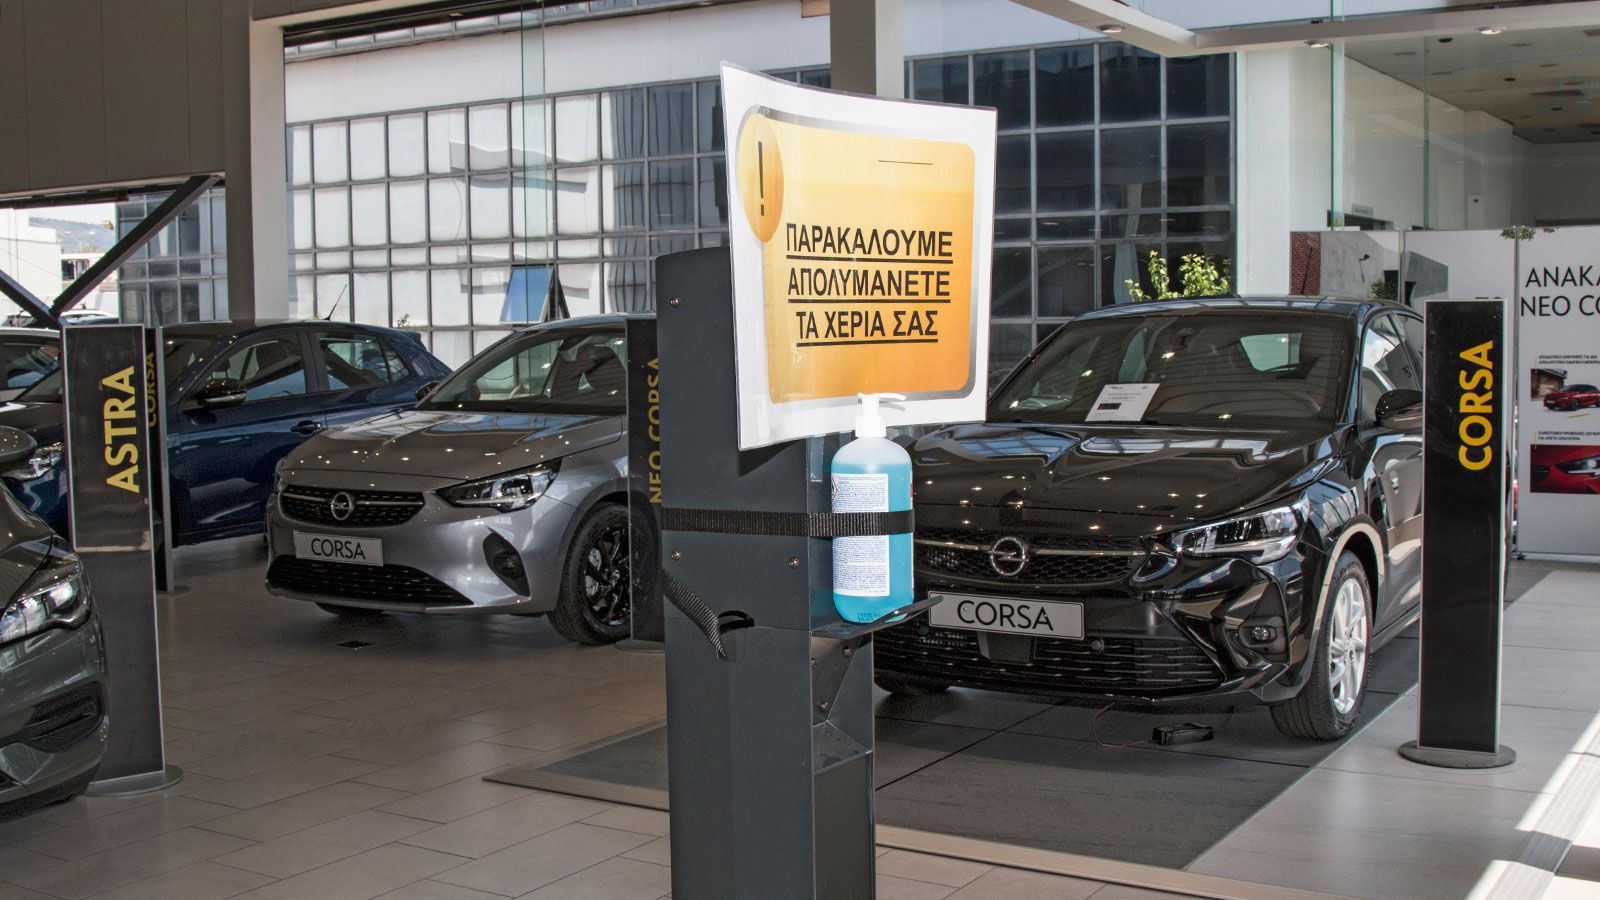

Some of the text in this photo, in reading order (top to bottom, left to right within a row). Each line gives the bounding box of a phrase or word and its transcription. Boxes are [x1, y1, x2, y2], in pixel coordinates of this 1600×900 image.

[786, 222, 953, 257] ΠΑΡΑΚΑΛΟΥΜΕ
[787, 267, 951, 296] ΑΠΟΛΥΜΑΝΕΤΕ
[1525, 265, 1600, 288] ΑΝΑΚ
[1579, 295, 1600, 317] C
[796, 310, 938, 339] ΤΑ ΧΕΡΙΑ ΣΑΣ
[1458, 340, 1493, 471] CORSA
[101, 365, 140, 494] ASTRA
[310, 538, 366, 560] CORSA
[957, 600, 1054, 631] CORSA
